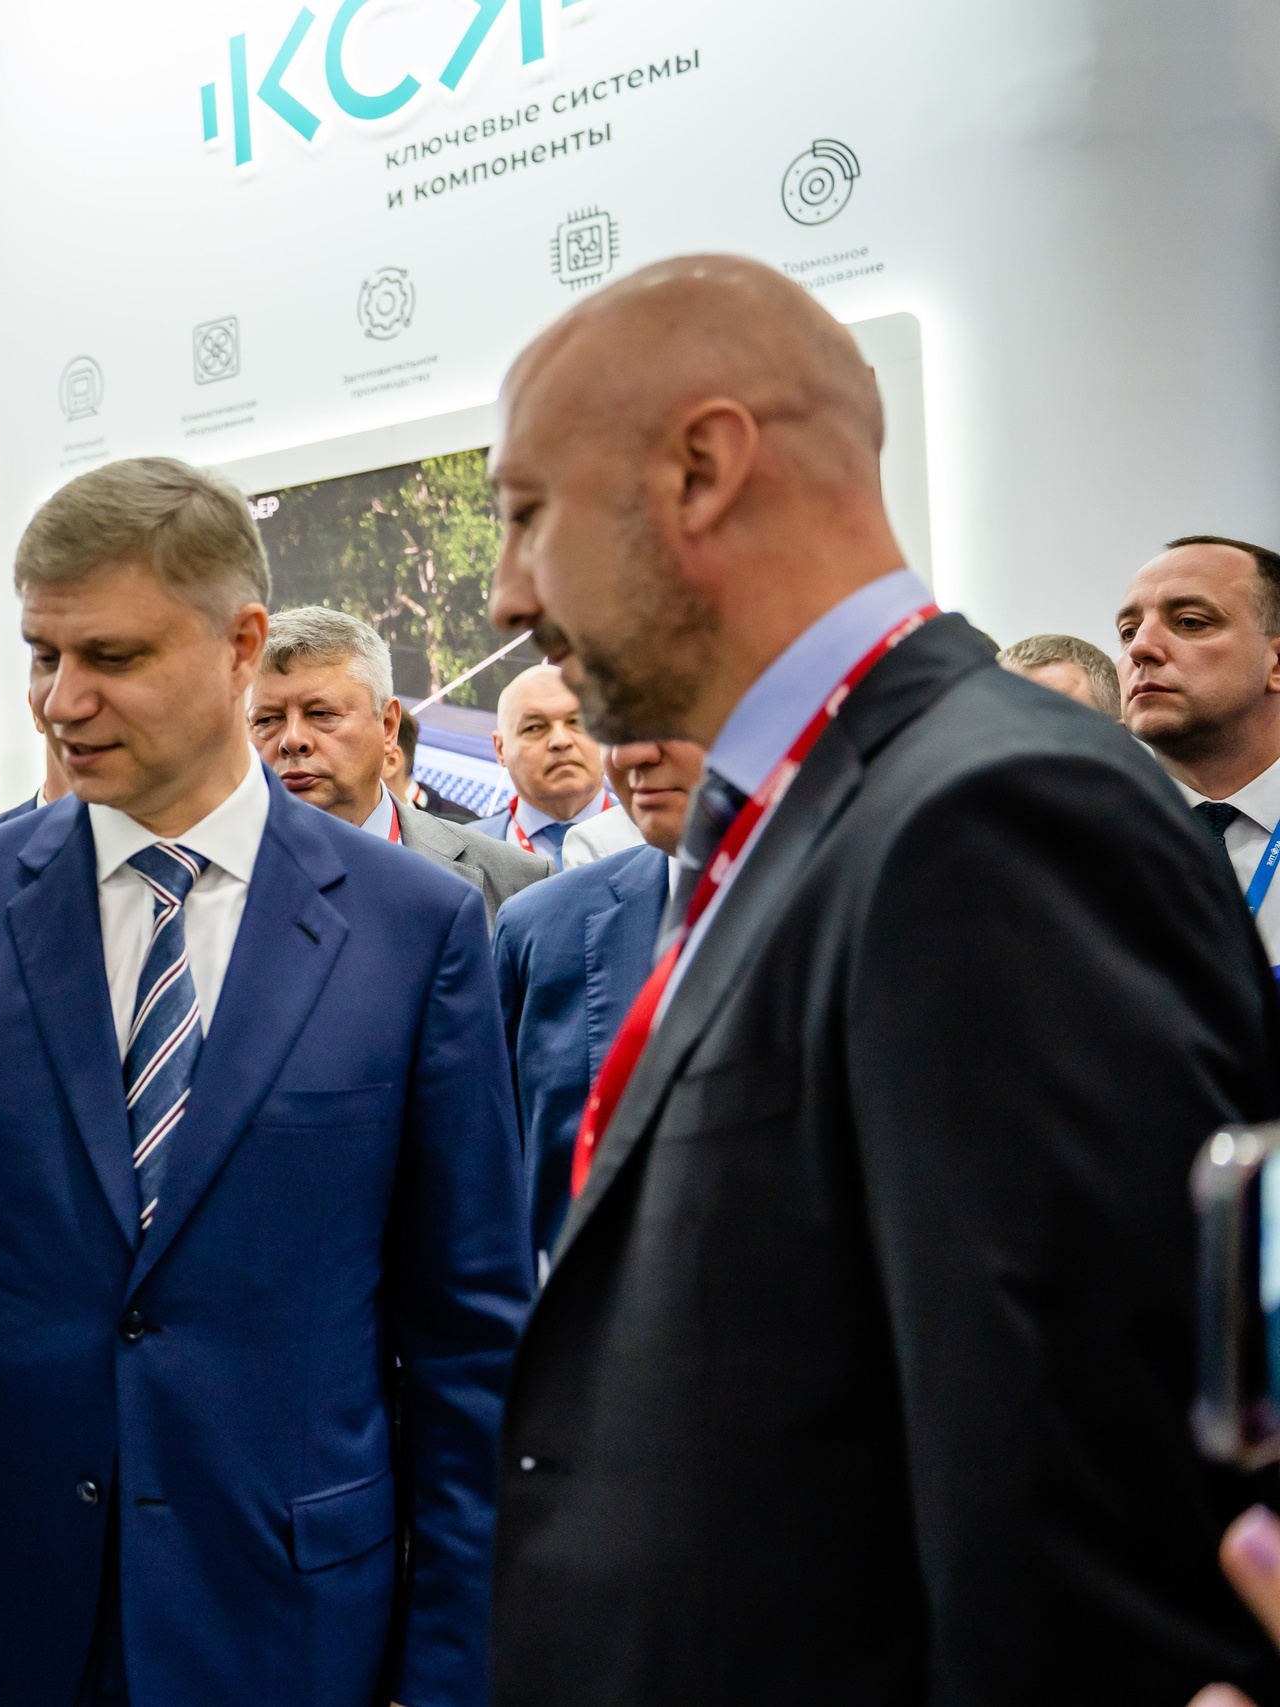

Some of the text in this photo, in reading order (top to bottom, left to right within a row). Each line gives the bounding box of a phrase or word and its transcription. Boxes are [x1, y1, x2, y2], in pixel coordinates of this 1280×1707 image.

[385, 49, 700, 168] ключевые системы
[387, 123, 612, 208] и компоненты
[783, 246, 868, 273] Тормозное
[799, 262, 884, 291] рудование
